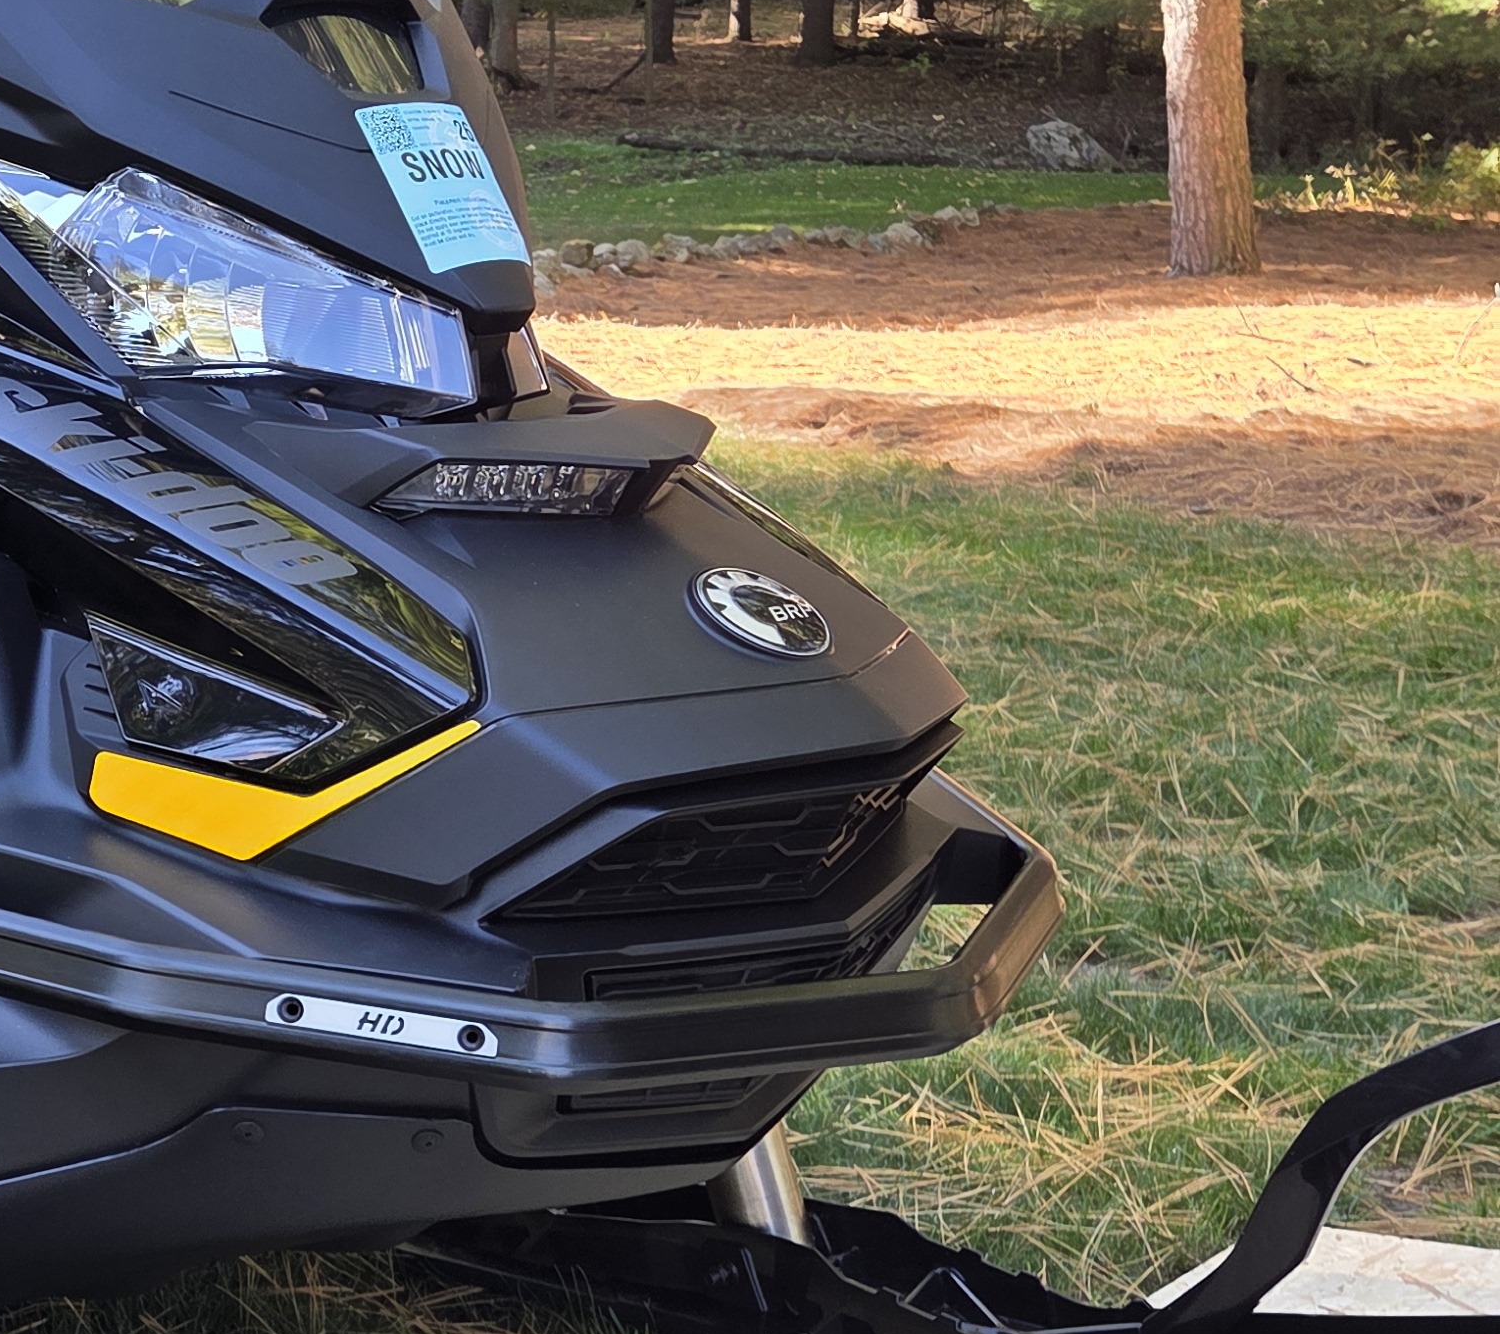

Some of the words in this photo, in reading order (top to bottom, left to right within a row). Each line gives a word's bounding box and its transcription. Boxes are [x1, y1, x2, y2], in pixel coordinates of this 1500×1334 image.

[453, 119, 475, 143] 26
[401, 148, 485, 183] SNOW
[768, 603, 813, 623] BRP
[356, 1011, 405, 1036] HD
